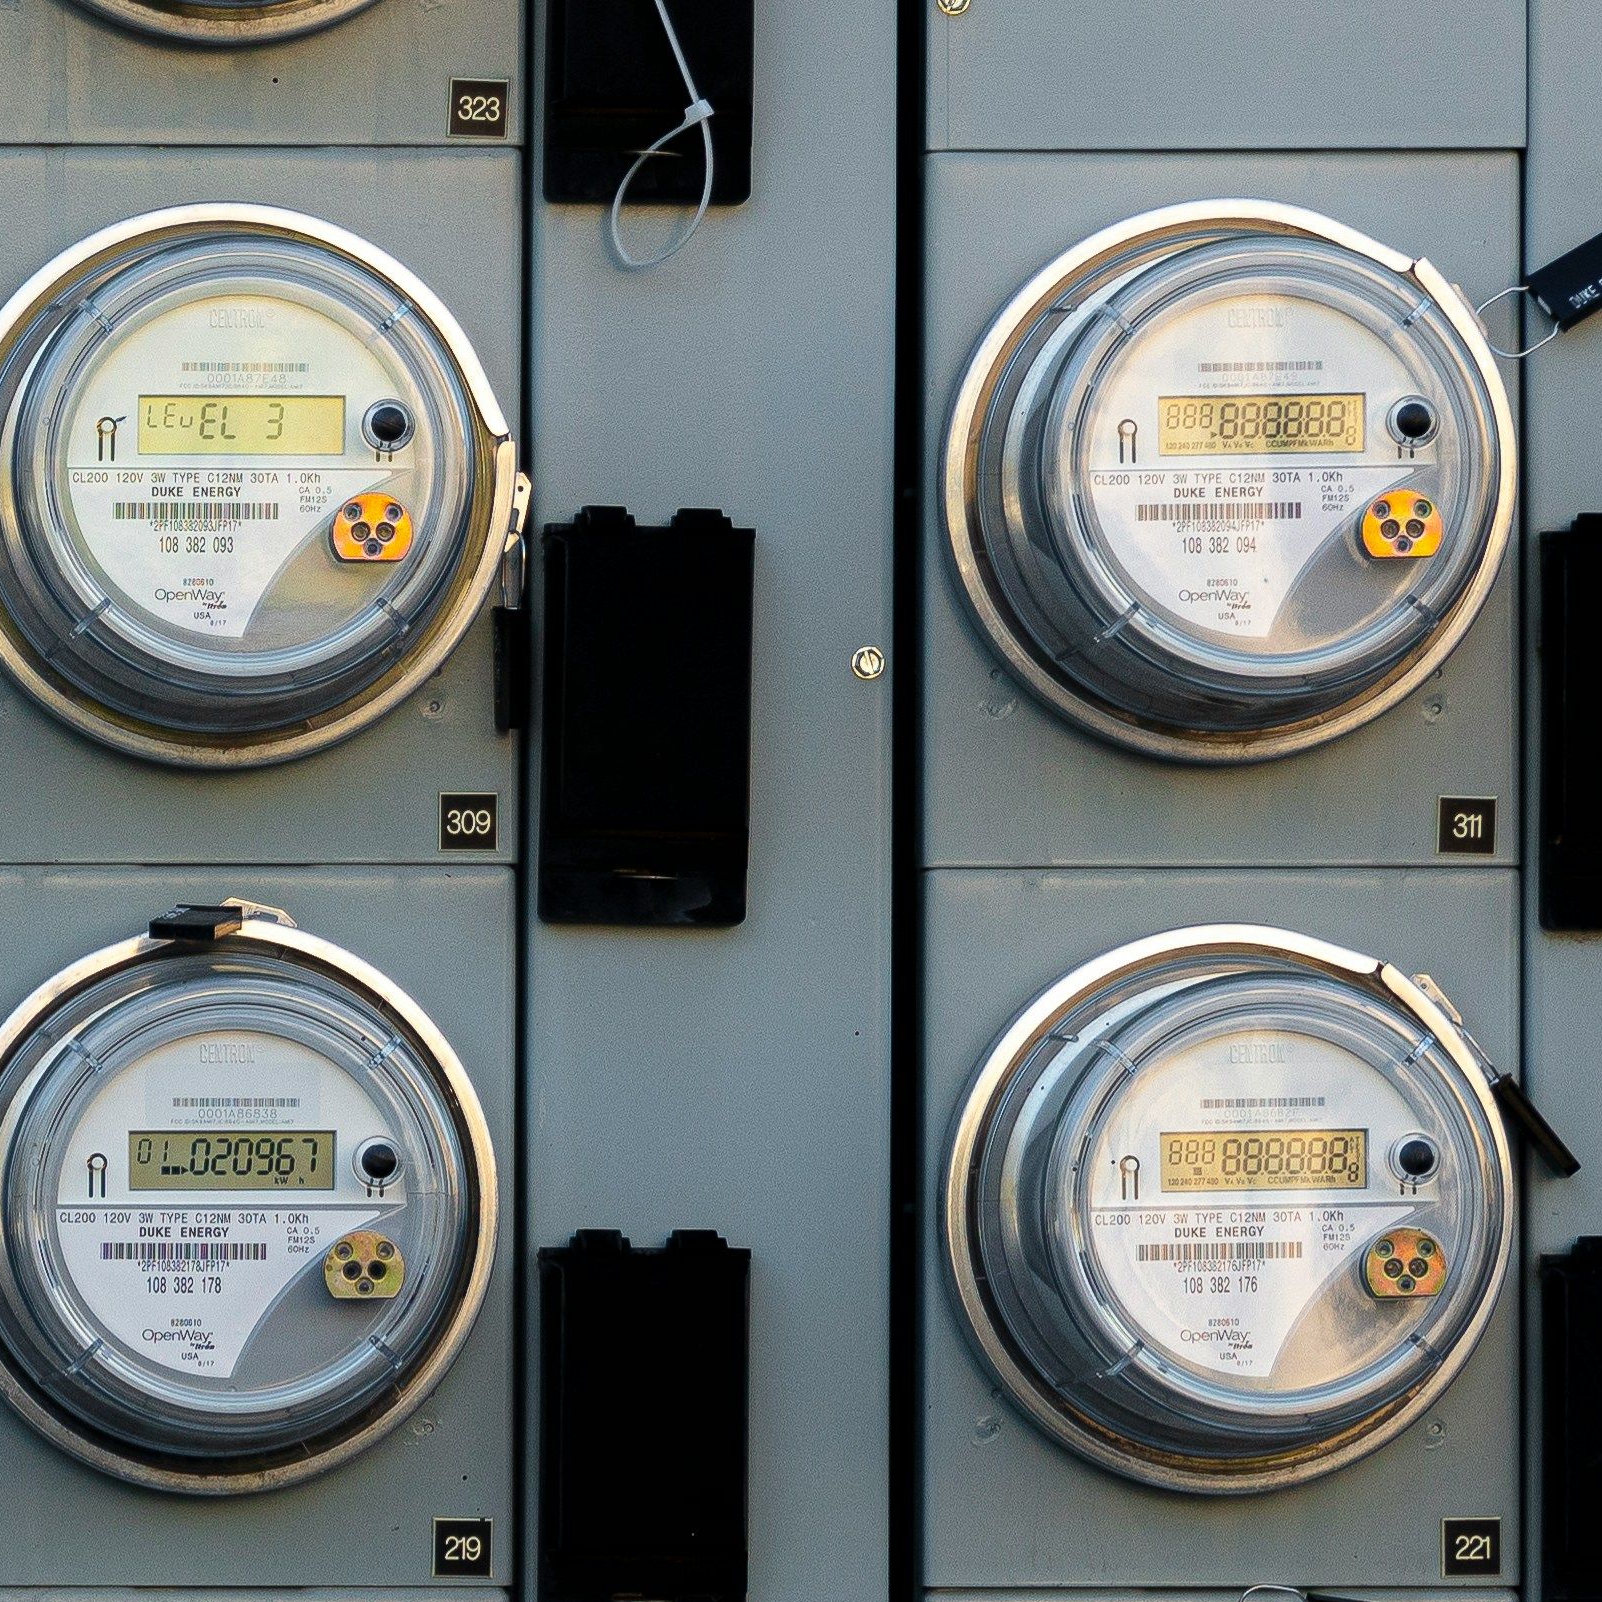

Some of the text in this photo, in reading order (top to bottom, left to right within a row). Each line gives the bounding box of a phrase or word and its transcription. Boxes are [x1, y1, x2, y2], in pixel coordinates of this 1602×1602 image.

[458, 96, 499, 121] 323
[151, 487, 242, 498] DUKE ENERGY
[1173, 486, 1264, 499] DUKE ENERGY
[158, 537, 234, 553] 108 382 093
[1182, 537, 1257, 555] 108 382 094
[447, 810, 490, 834] 309
[1453, 814, 1482, 837] 311
[190, 1137, 319, 1174] 020967
[59, 1212, 96, 1223] CL200
[103, 1212, 131, 1223] 120V
[138, 1212, 154, 1223] 3W
[160, 1212, 188, 1223] TYPE
[195, 1212, 231, 1223] C12NM
[275, 1212, 309, 1223] 1.0Kh
[139, 1227, 229, 1237] DUKE ENERGY
[1174, 1226, 1265, 1239] DUKE ENERGY
[147, 1277, 222, 1293] 108 382 178
[1183, 1277, 1258, 1294] 108 382 176
[141, 1329, 211, 1343] OpenWay
[445, 1536, 480, 1560] 219
[1456, 1536, 1490, 1559] 221
